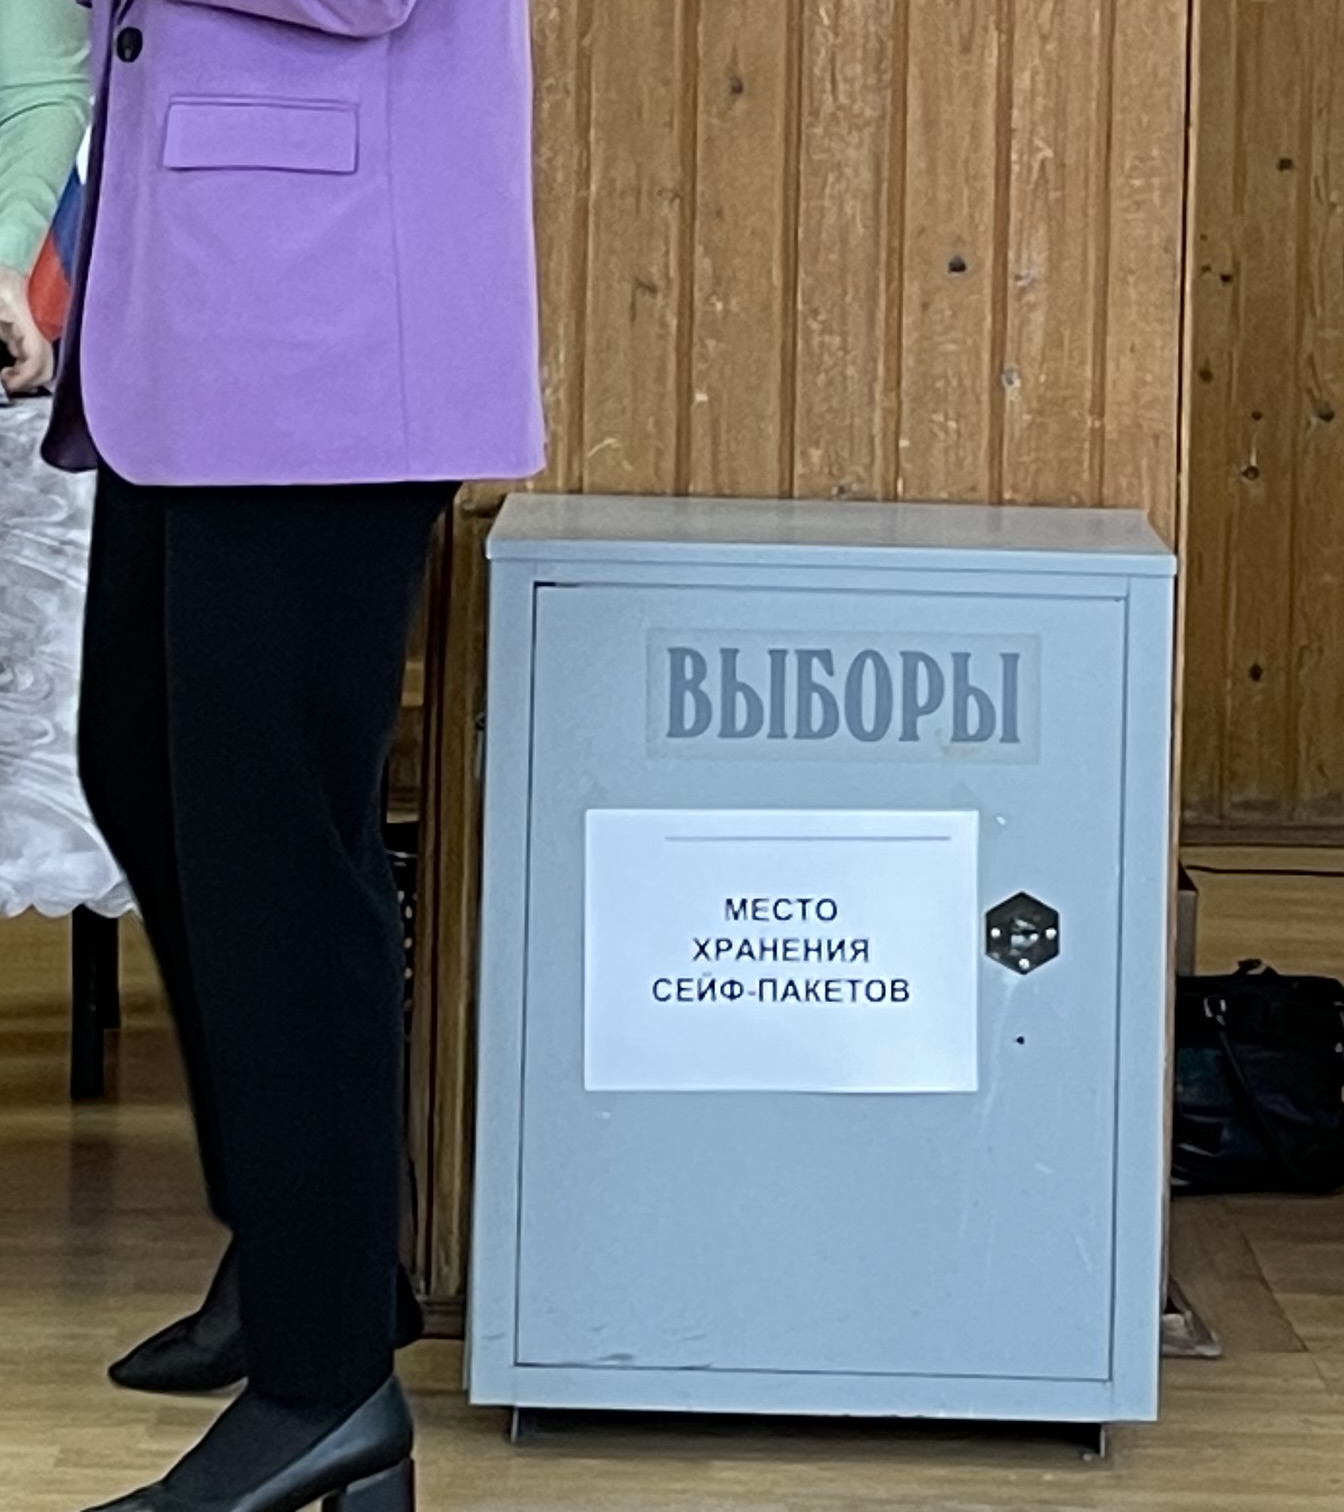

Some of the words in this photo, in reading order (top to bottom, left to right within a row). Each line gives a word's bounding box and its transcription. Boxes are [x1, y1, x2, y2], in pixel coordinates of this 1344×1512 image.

[666, 646, 1021, 744] ВЫБОРЫ
[725, 897, 838, 922] МЕСТО
[692, 938, 870, 963] ХРАНЕНИЯ
[652, 972, 911, 1004] СЕЙФ-ПАКЕТОВ
